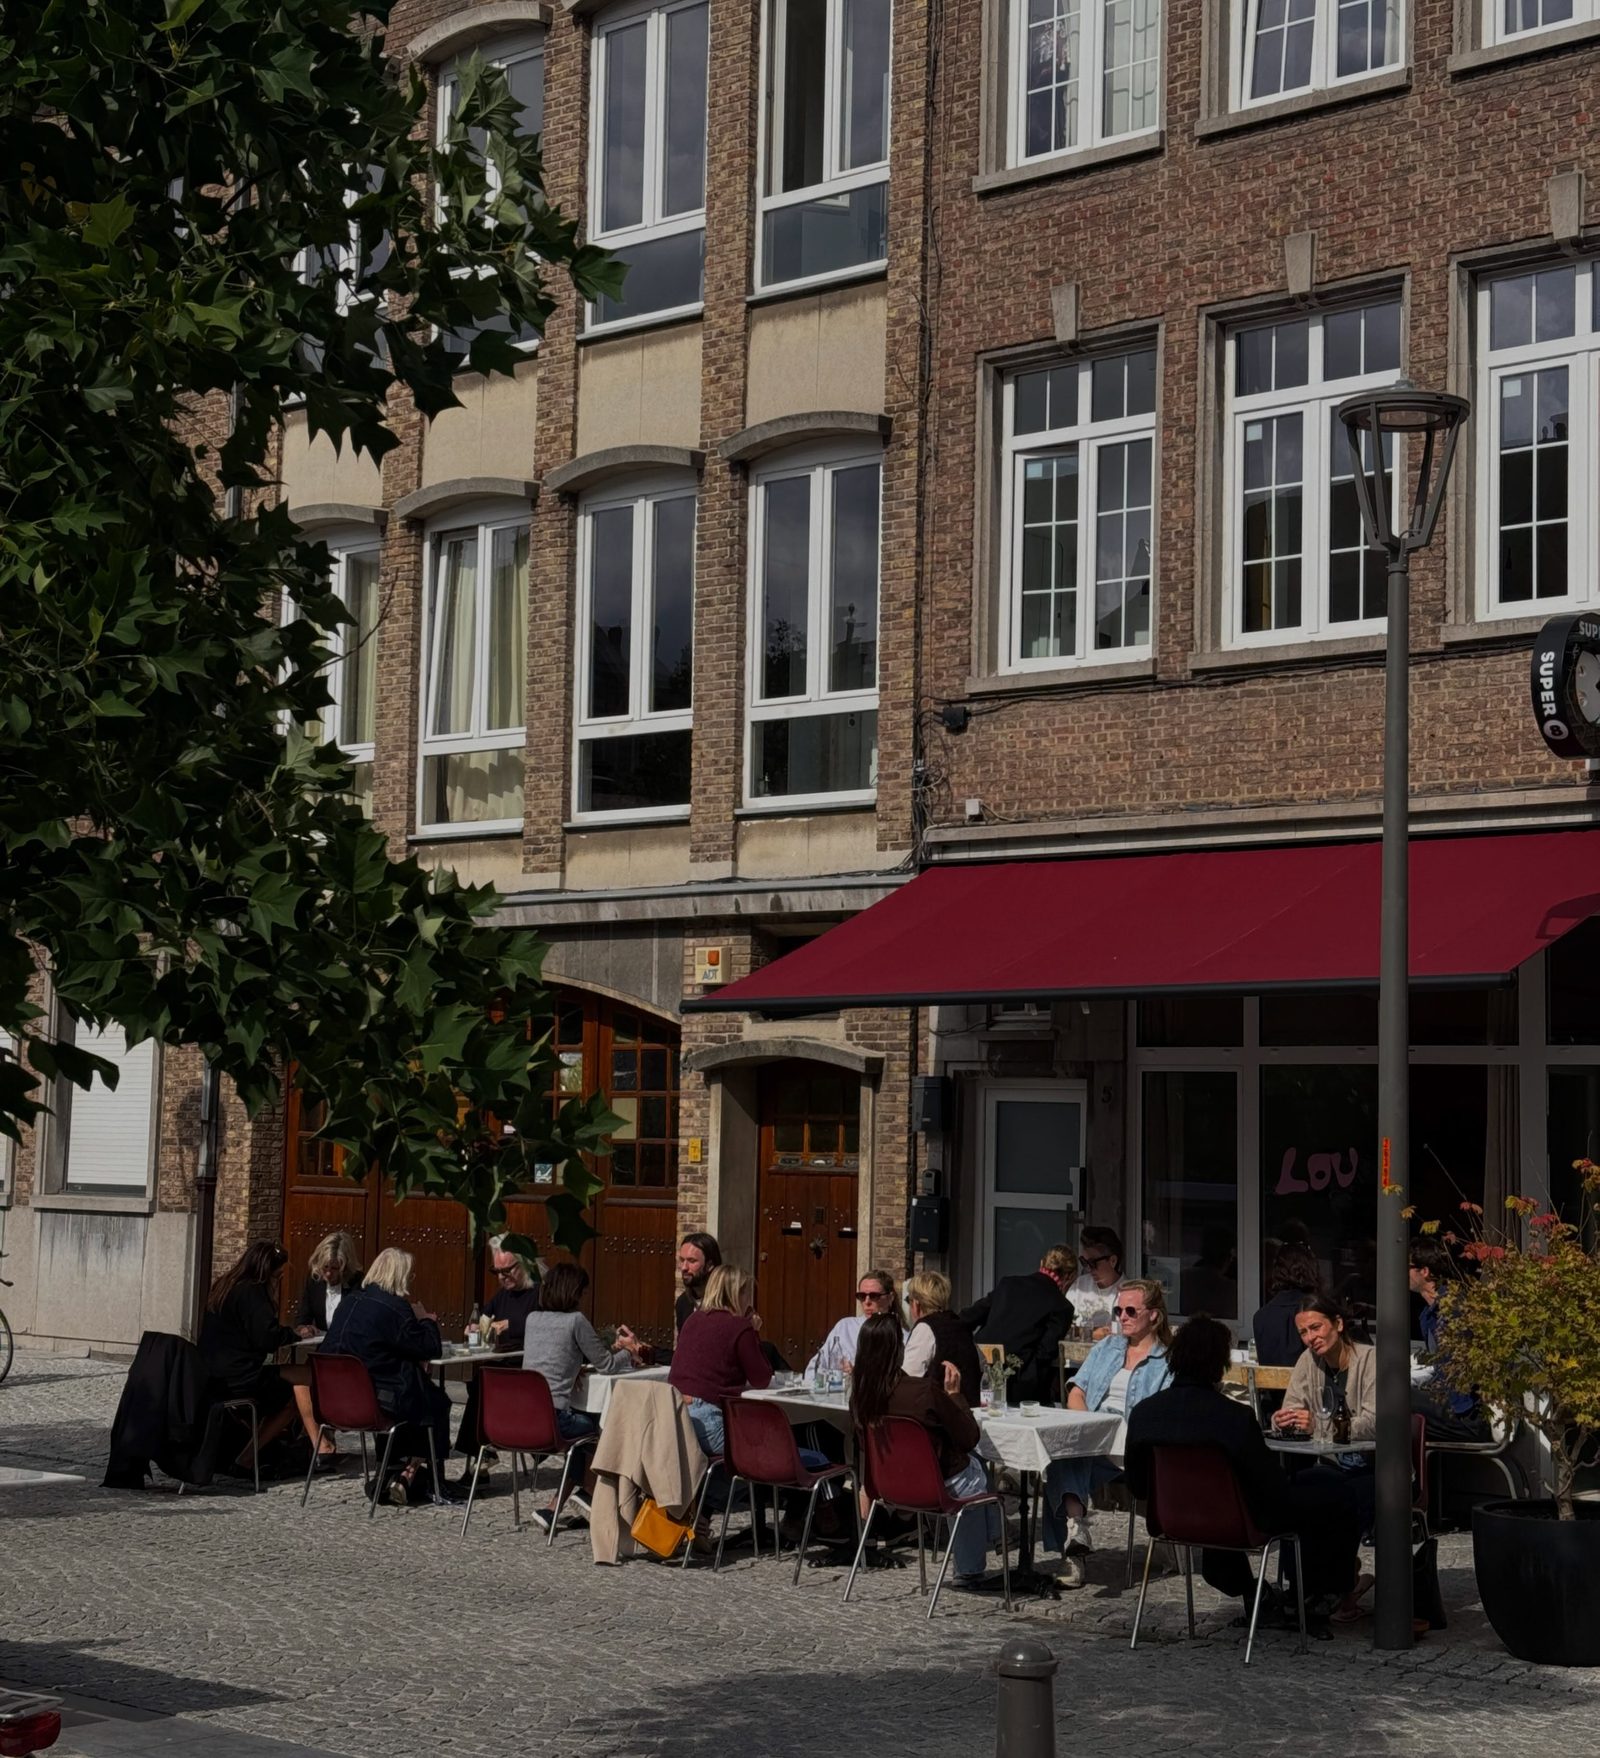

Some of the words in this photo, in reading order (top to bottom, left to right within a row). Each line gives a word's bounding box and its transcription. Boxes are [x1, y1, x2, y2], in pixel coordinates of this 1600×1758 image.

[1579, 620, 1600, 640] SUP
[1539, 650, 1557, 717] SUPER
[702, 968, 719, 980] ADT
[1102, 1086, 1113, 1104] 5
